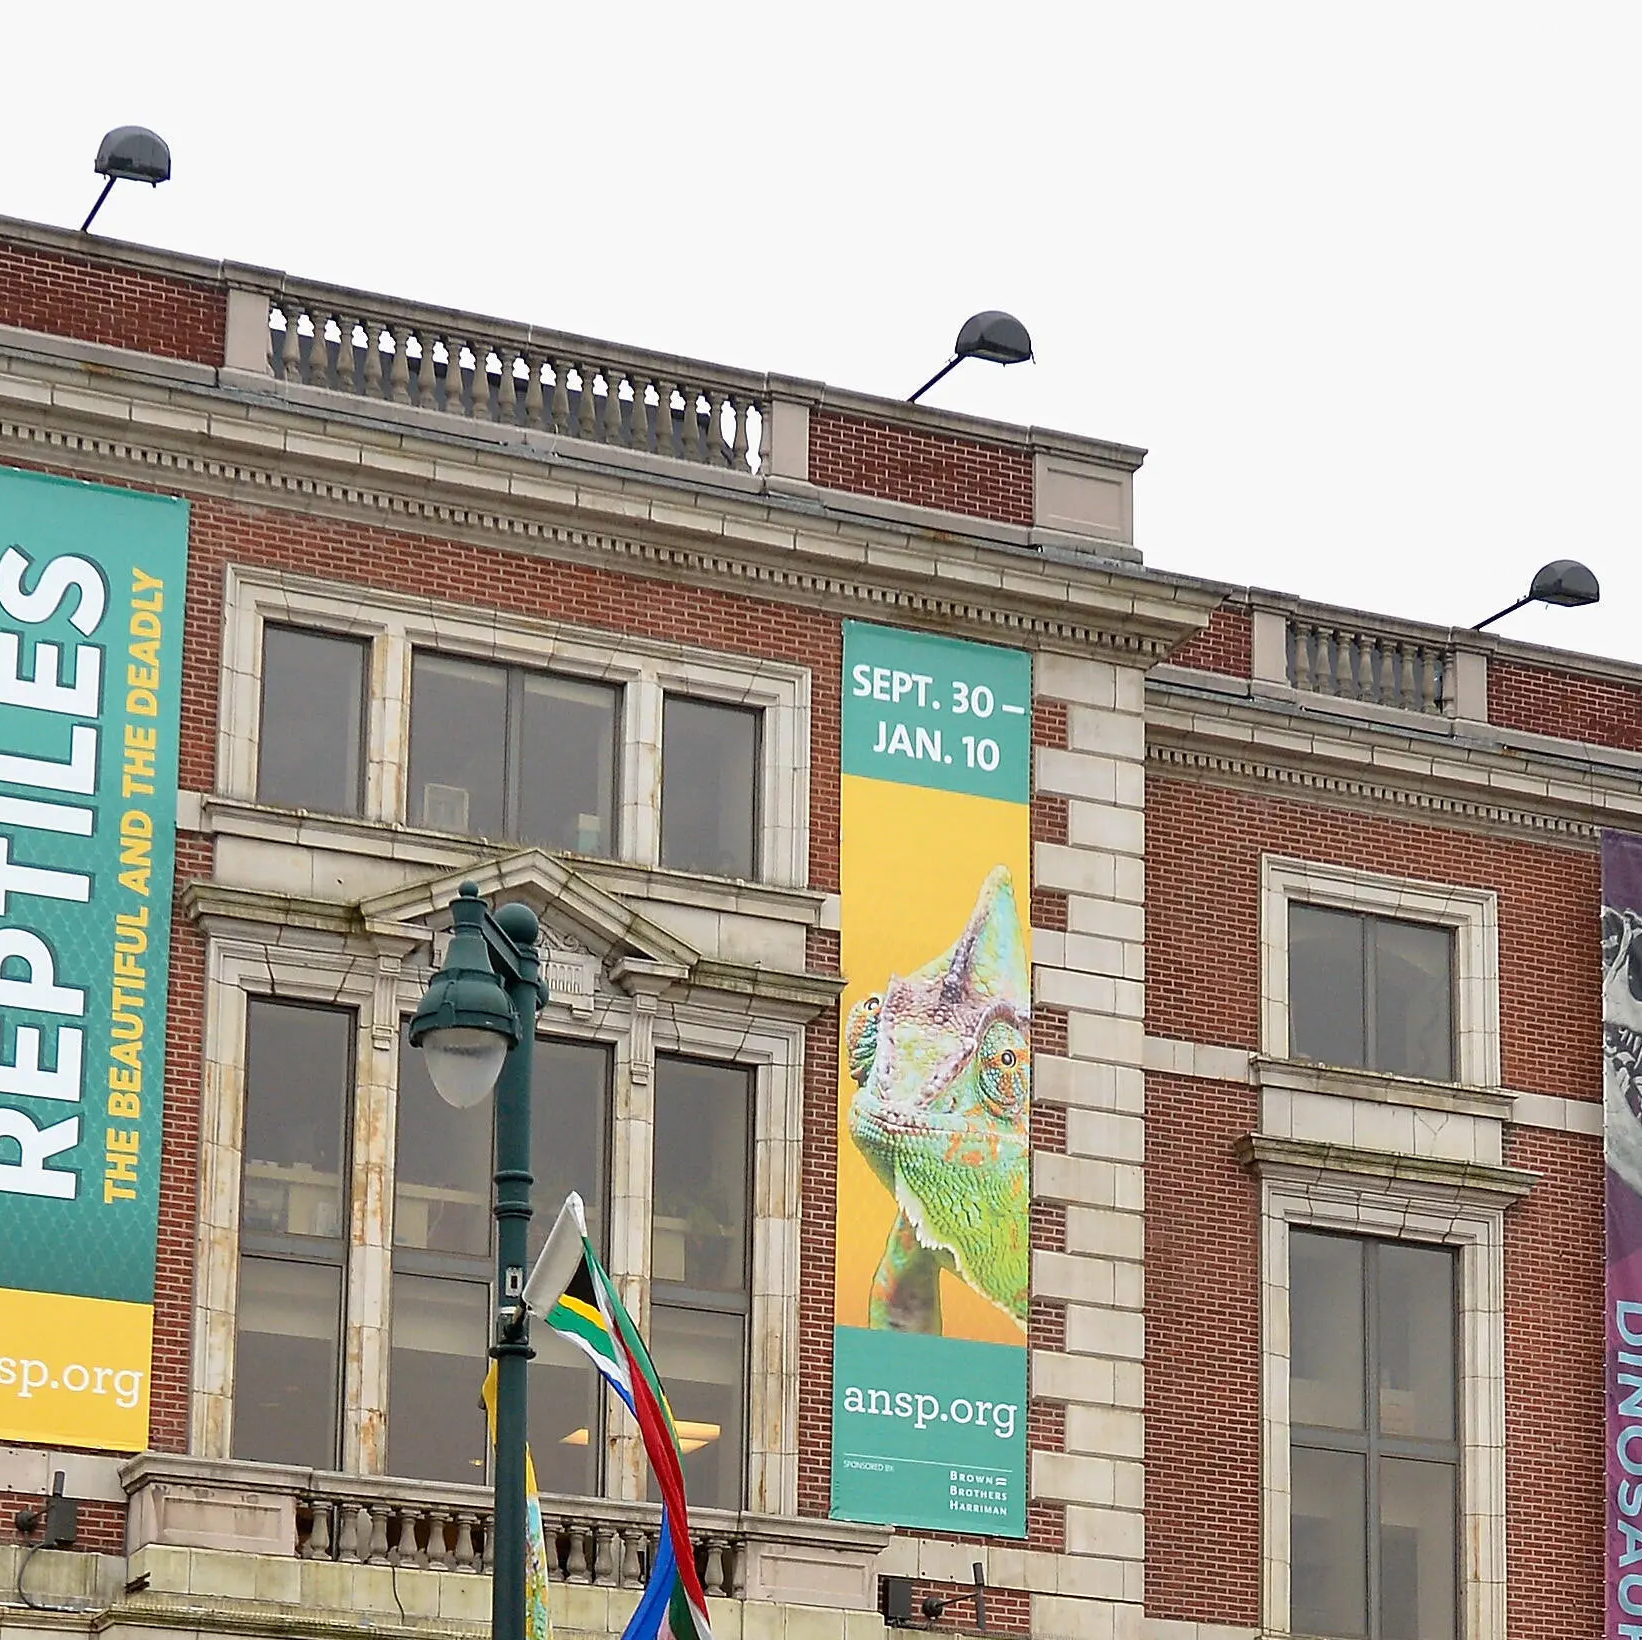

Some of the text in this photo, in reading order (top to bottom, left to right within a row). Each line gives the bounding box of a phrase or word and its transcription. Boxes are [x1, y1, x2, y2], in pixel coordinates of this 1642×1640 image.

[852, 664, 941, 710] SEPT.
[873, 720, 1000, 772] JAN. 10
[104, 568, 164, 1204] THE BEAUTIFUL AND THE DEADLY
[843, 1386, 1018, 1438] ansp.org
[949, 1485, 1007, 1501] BROTHERS
[949, 1499, 1007, 1516] HARRIMAN
